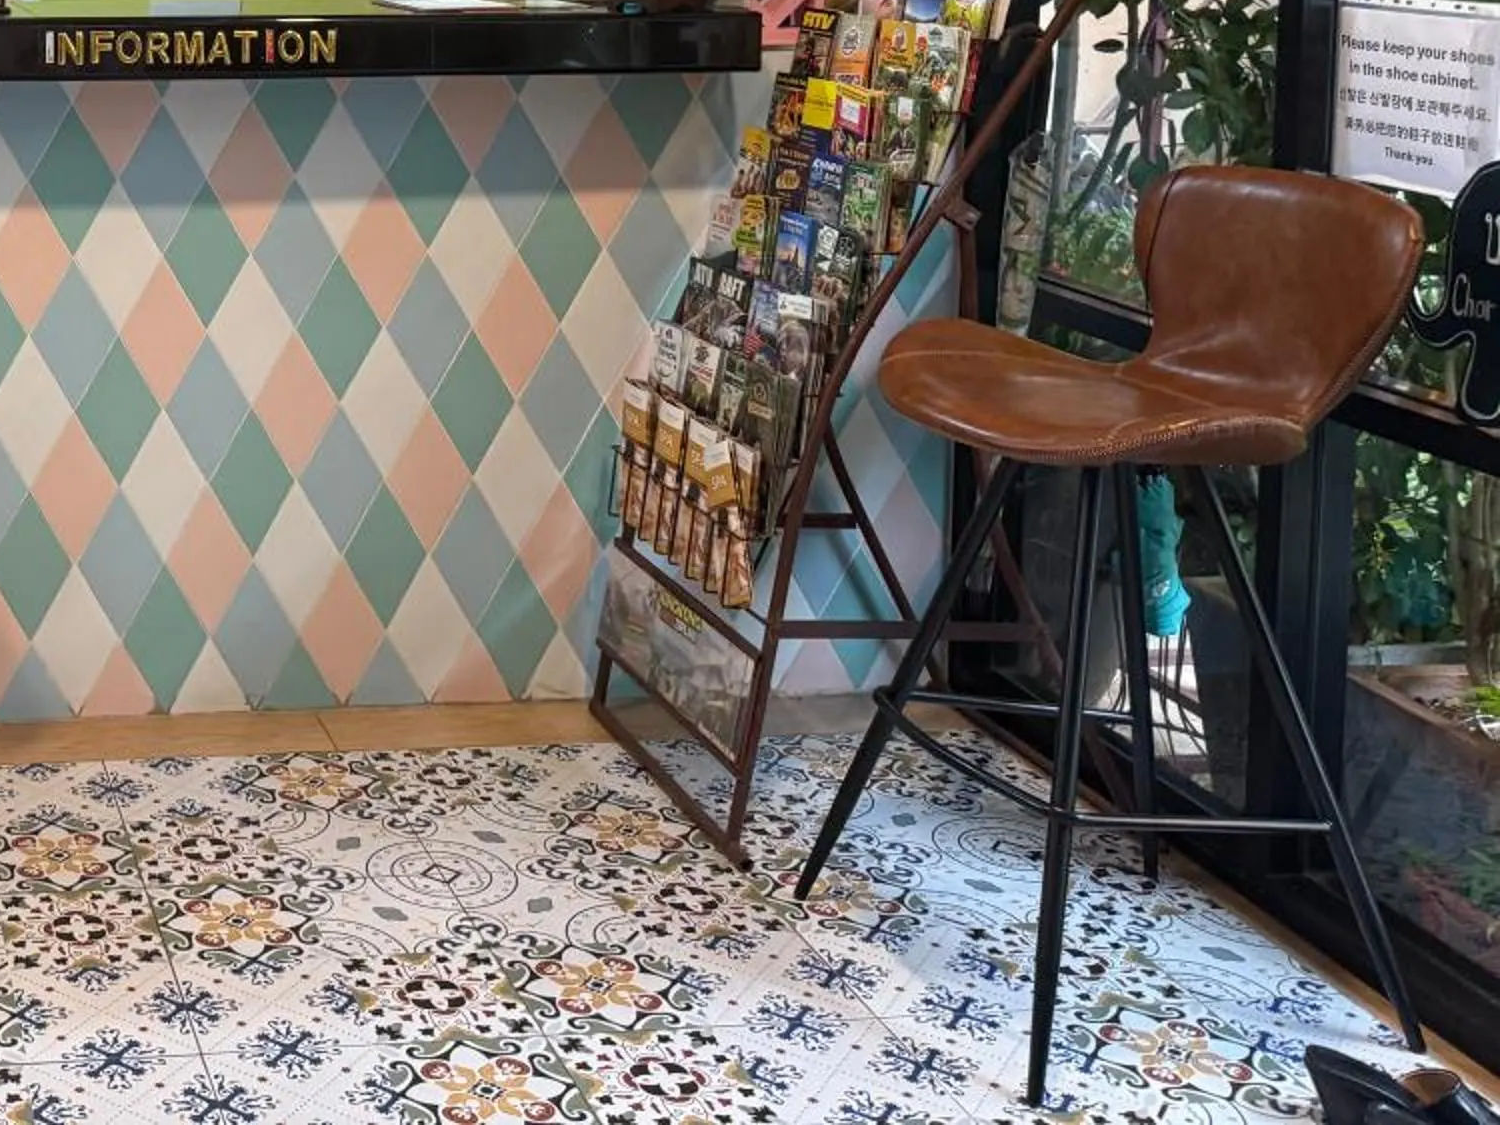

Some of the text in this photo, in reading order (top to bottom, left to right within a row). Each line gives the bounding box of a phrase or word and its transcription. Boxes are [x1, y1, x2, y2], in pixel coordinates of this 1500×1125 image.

[45, 28, 338, 65] INFORMATION
[1341, 34, 1495, 66] Please keep your shoes
[1349, 59, 1479, 91] in the shoe cabinet.
